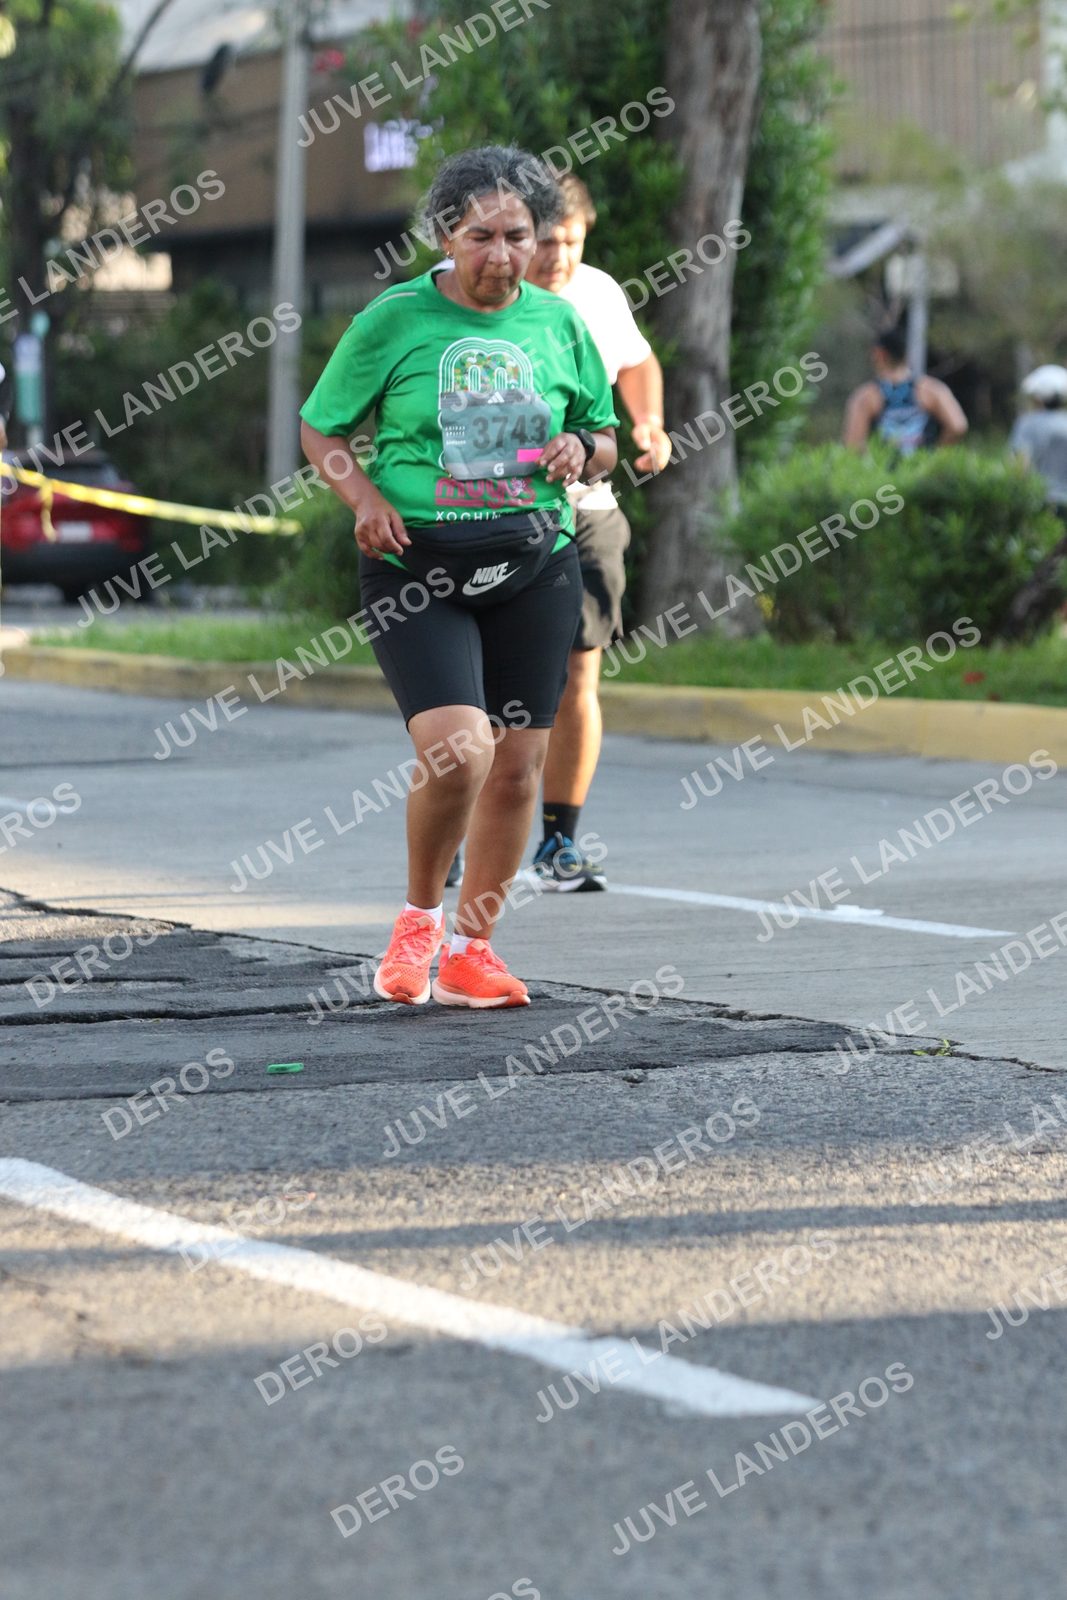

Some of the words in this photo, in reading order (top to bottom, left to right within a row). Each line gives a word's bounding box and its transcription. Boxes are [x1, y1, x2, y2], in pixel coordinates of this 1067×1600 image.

[473, 413, 548, 450] 3743
[493, 463, 505, 476] G
[471, 561, 509, 584] NIKE
